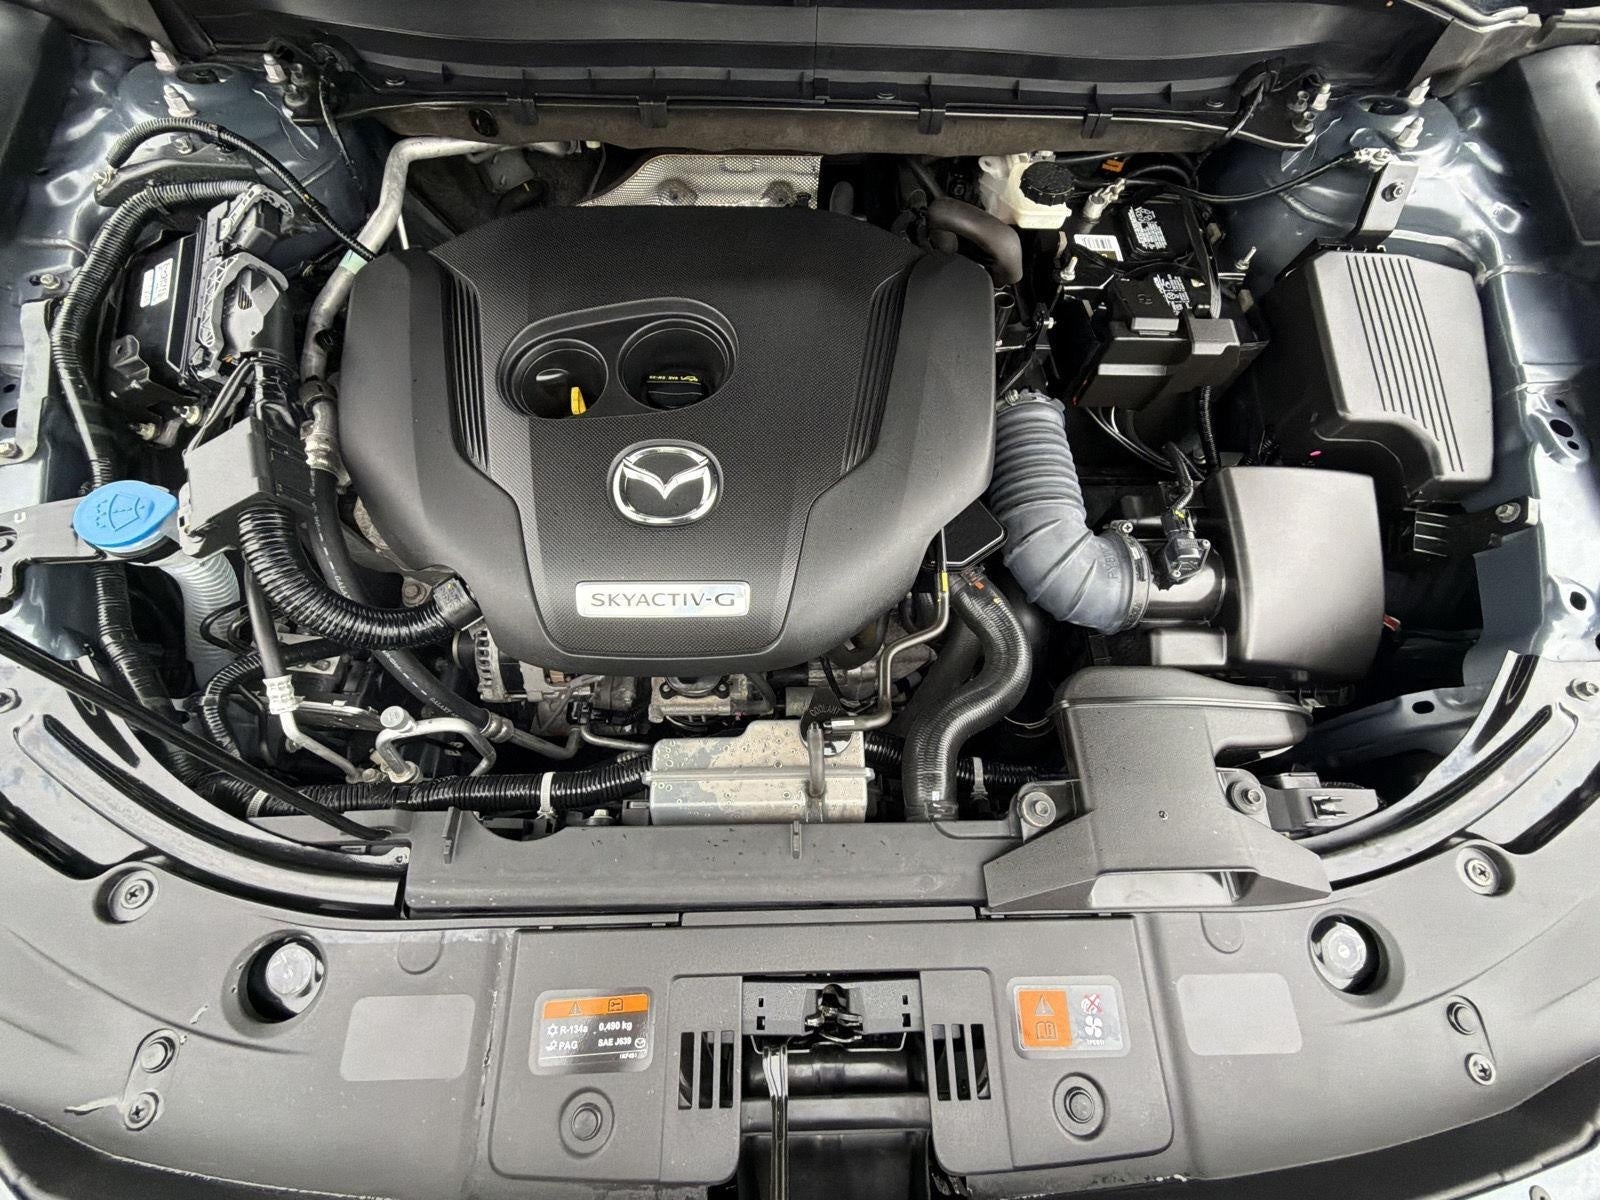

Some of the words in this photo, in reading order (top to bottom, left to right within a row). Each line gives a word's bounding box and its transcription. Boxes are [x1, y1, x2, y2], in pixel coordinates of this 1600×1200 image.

[590, 592, 736, 607] SKYACTIV-G
[559, 1024, 588, 1034] R-134a
[621, 1020, 633, 1031] kg
[558, 1040, 578, 1050] PAG
[597, 1038, 614, 1047] SAE
